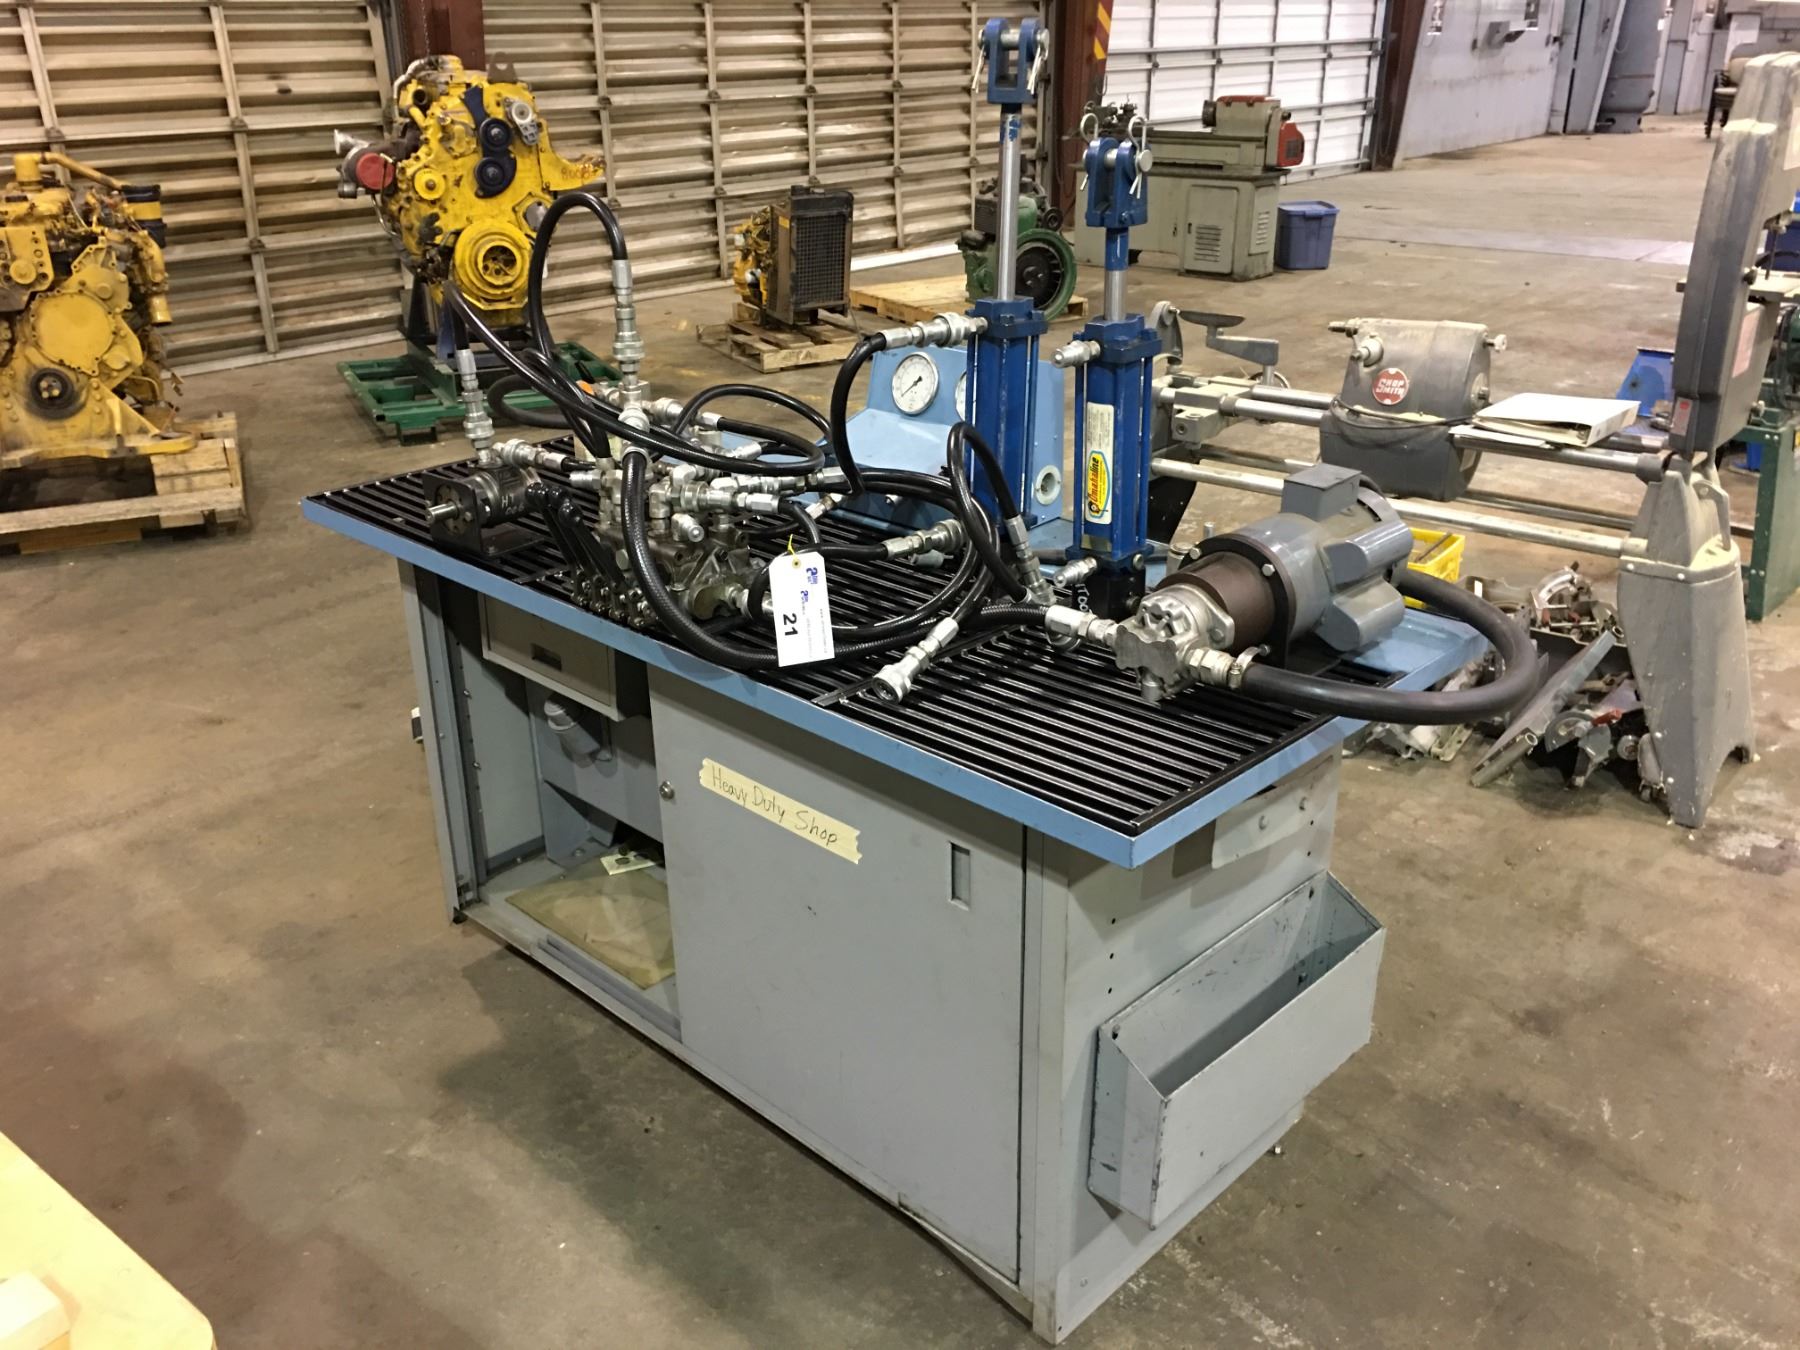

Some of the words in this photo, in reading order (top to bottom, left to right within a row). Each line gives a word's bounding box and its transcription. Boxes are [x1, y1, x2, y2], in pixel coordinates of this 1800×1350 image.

[783, 613, 798, 636] 21
[712, 766, 748, 807] Heavy
[752, 785, 786, 823] Duty
[794, 810, 838, 846] Shop
